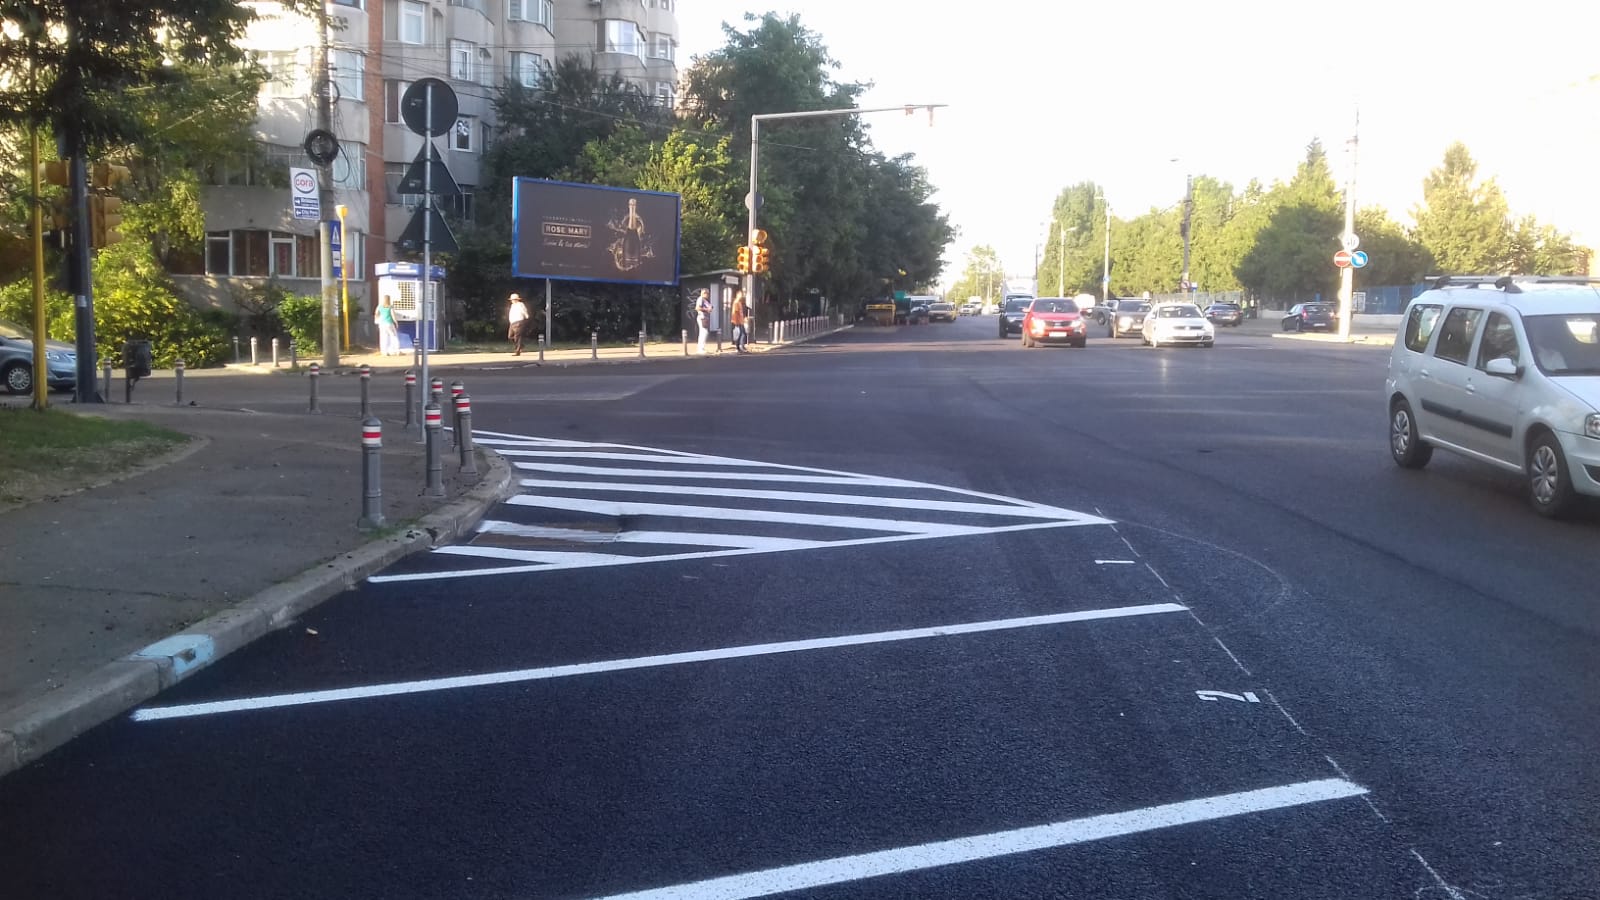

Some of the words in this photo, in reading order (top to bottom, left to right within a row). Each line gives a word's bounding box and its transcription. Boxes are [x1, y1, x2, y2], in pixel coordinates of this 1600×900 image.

[295, 179, 314, 188] cora
[545, 225, 567, 234] ROSE
[568, 226, 588, 236] MARY
